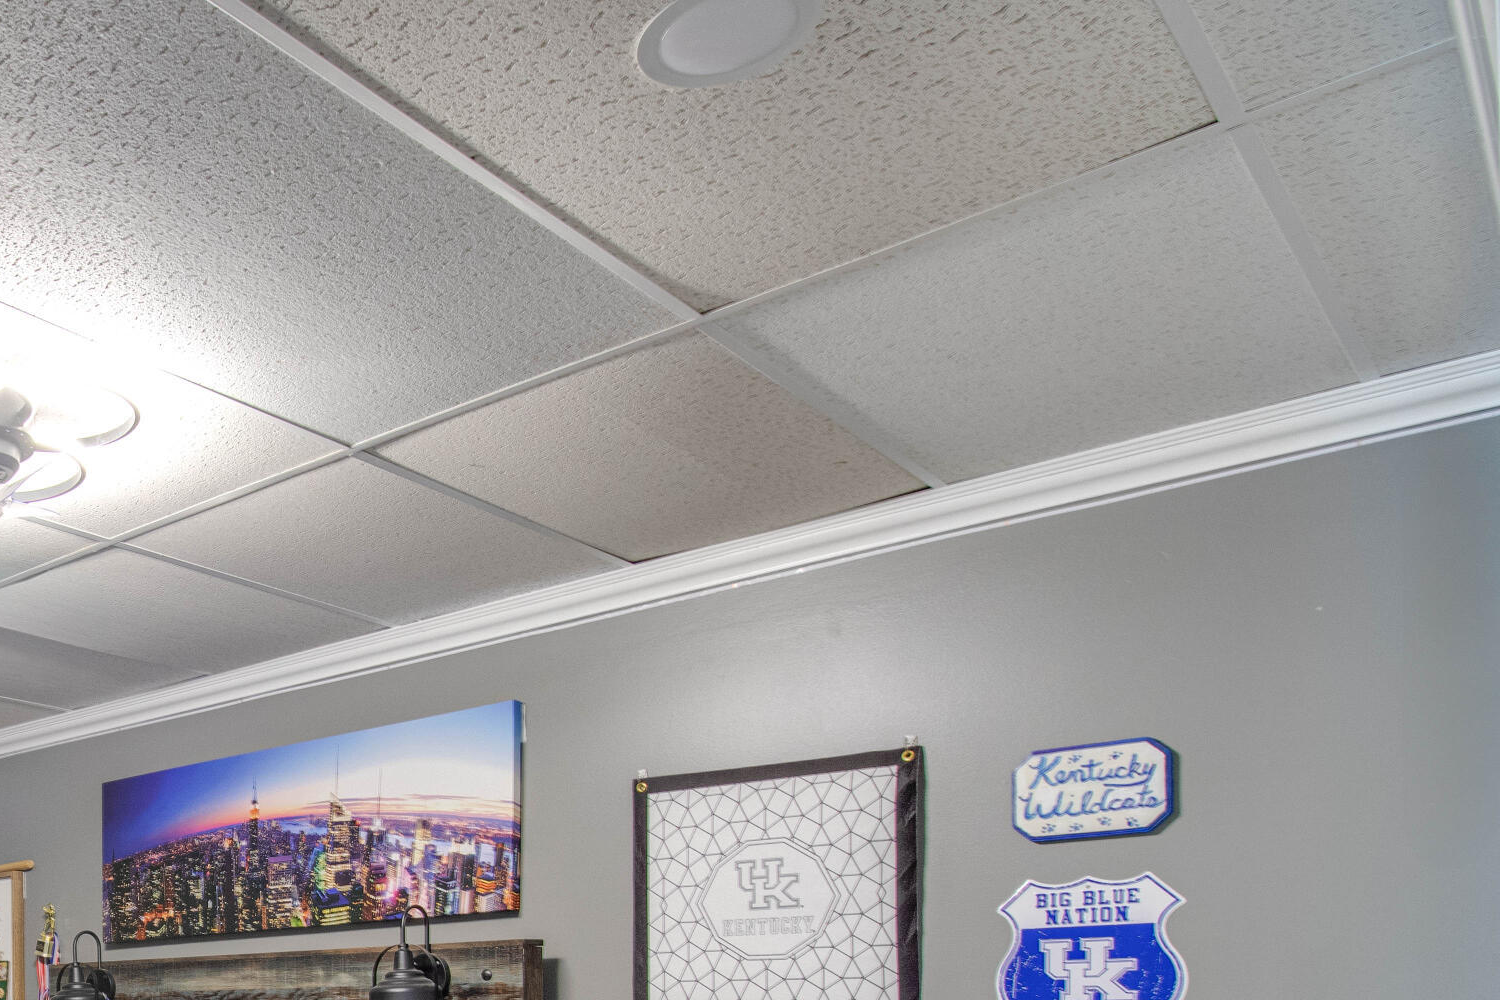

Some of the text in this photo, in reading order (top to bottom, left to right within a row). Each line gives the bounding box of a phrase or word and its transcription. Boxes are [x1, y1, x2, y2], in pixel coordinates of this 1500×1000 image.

[1028, 753, 1157, 788] Kentucky
[1018, 785, 1165, 820] Wildcats
[734, 857, 800, 910] UK
[1035, 887, 1140, 909] BIG BLUE
[722, 915, 815, 936] KENTUCKY
[1045, 905, 1130, 925] NATION
